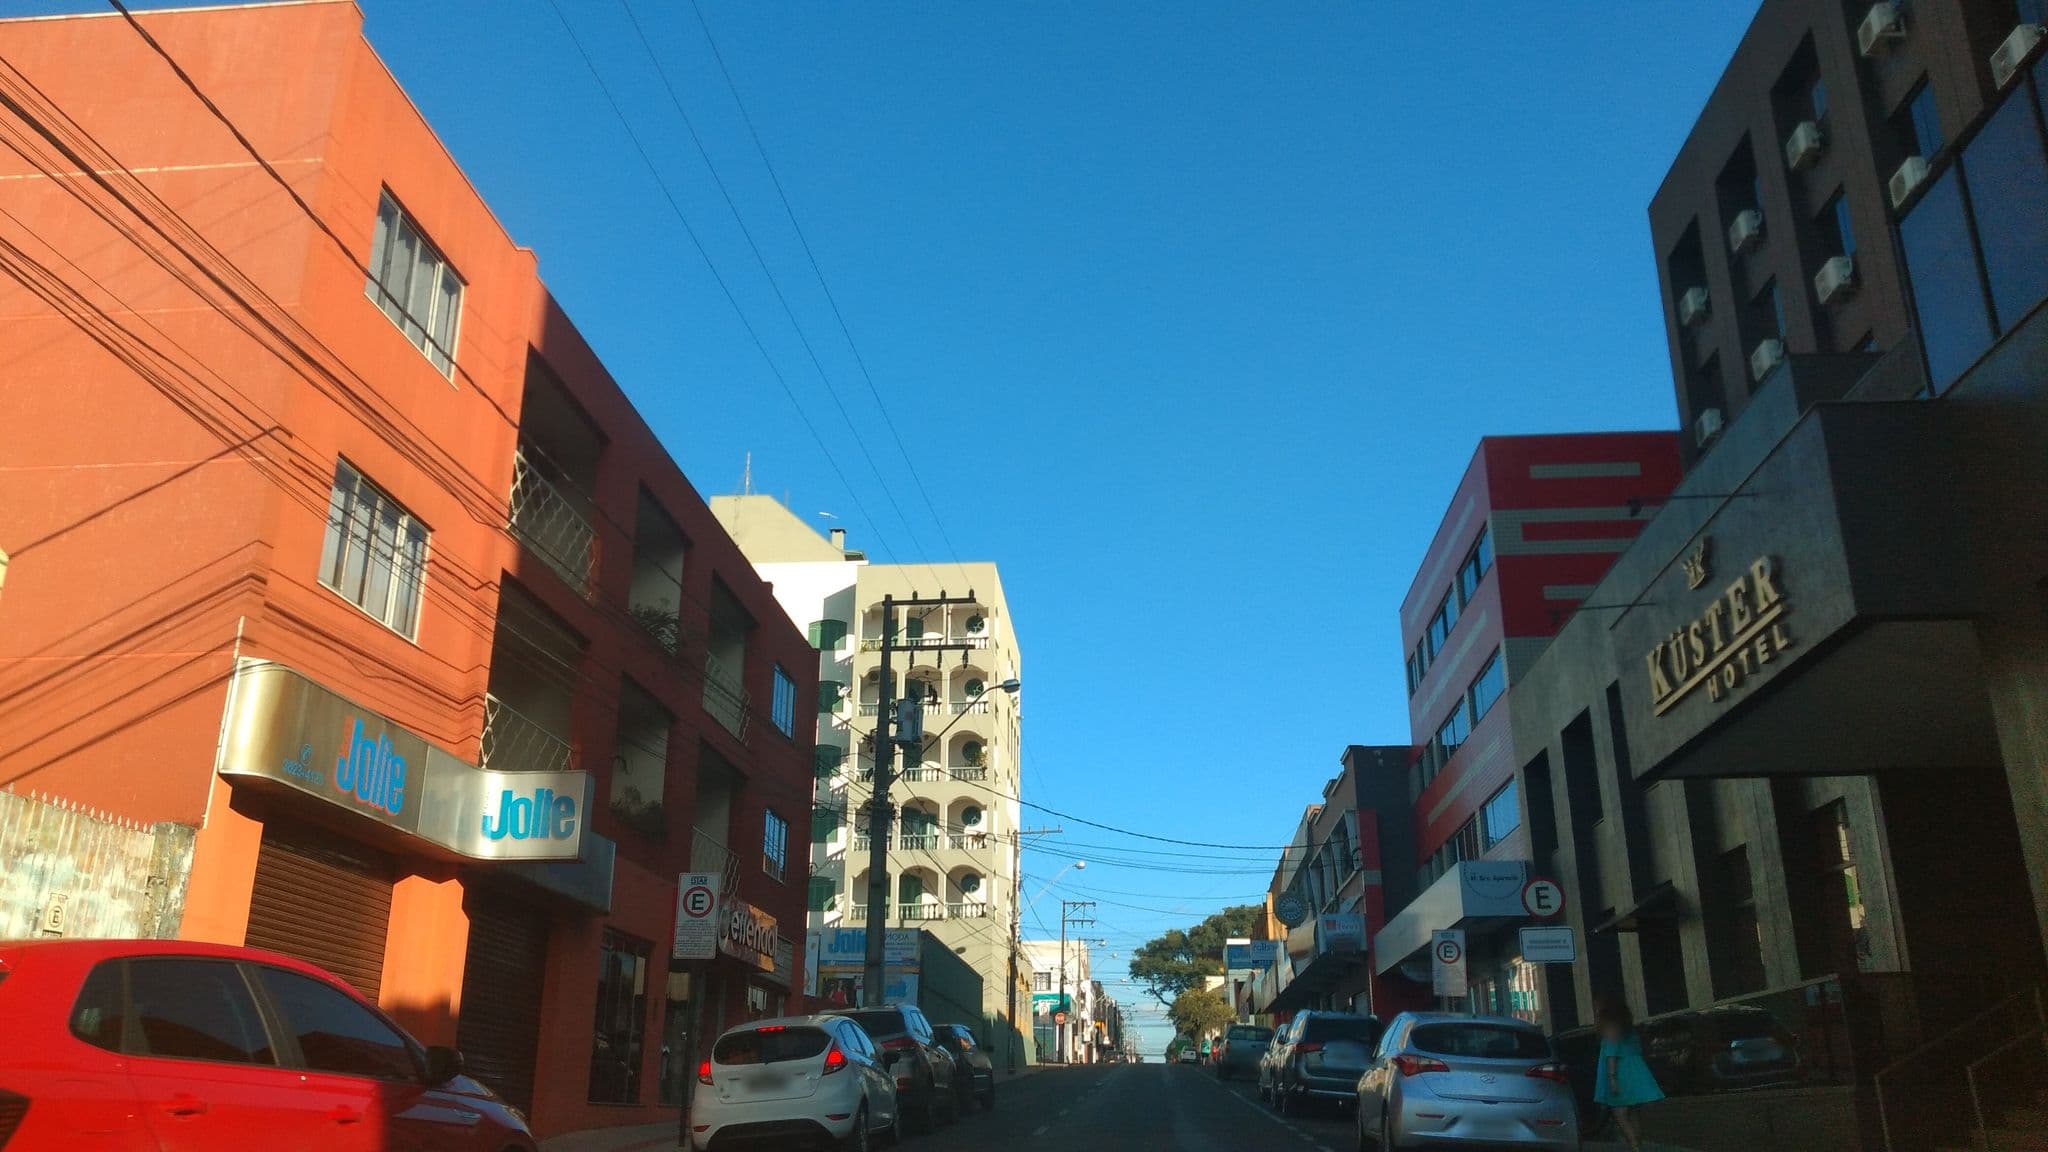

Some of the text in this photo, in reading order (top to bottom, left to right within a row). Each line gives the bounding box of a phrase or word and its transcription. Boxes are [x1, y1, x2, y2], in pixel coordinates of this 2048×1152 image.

[1646, 555, 1780, 705] KÜSTER
[1707, 624, 1788, 702] HOTEL
[336, 718, 406, 815] Jolie
[482, 788, 576, 840] Jolie
[692, 893, 704, 911] E
[1535, 886, 1551, 909] E
[1443, 945, 1454, 958] E
